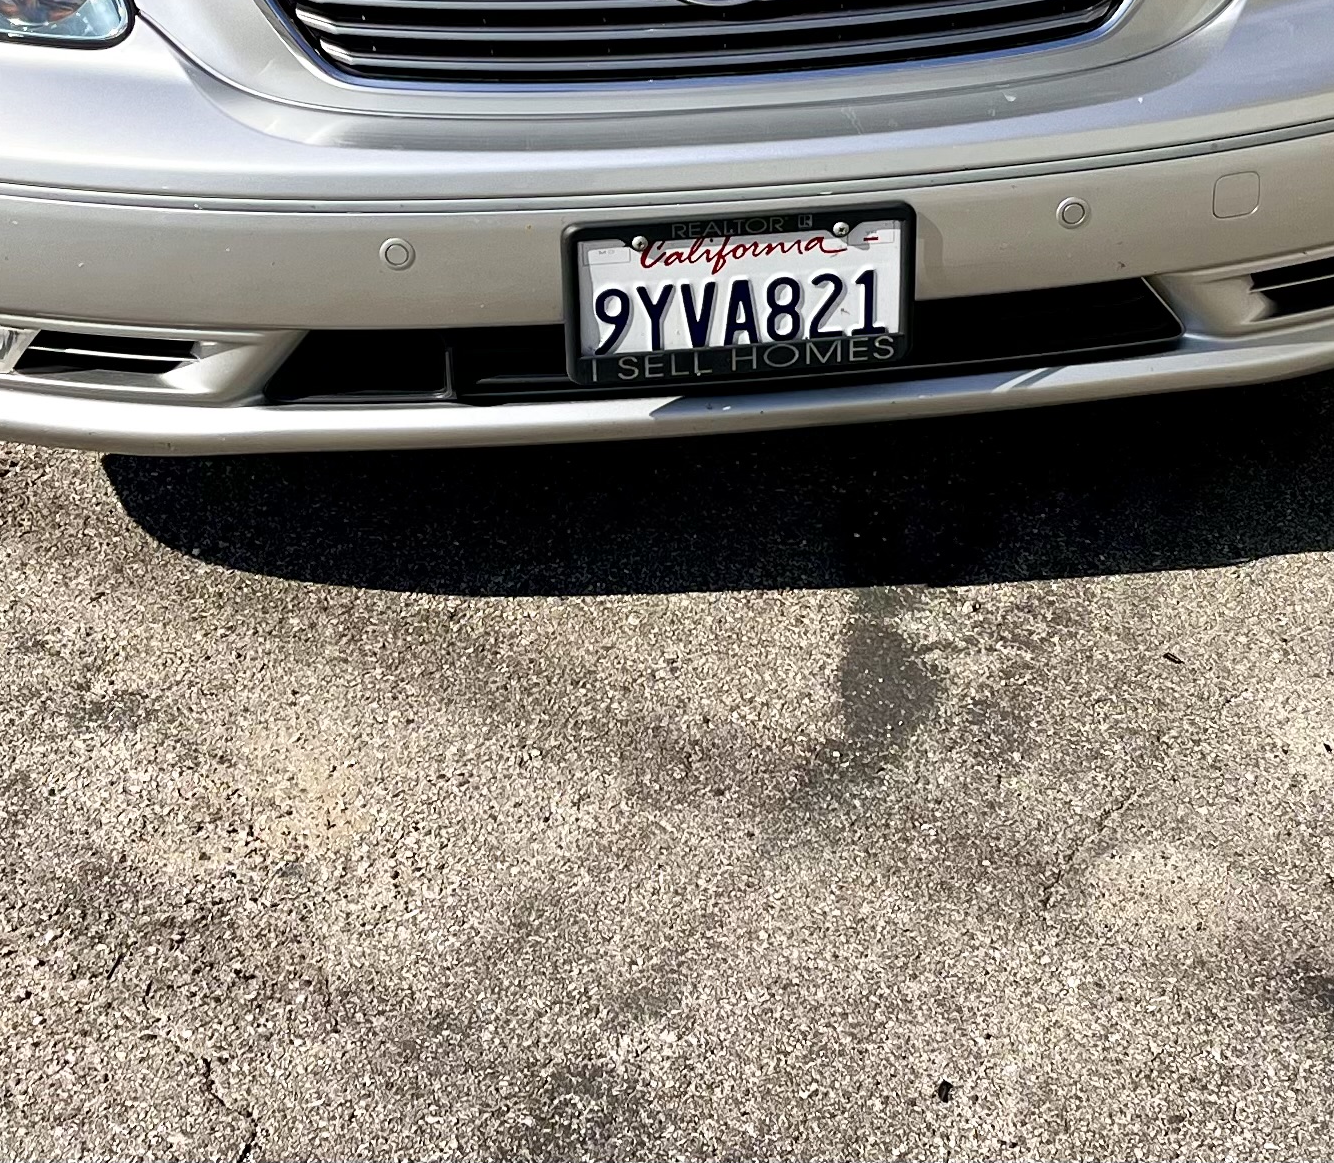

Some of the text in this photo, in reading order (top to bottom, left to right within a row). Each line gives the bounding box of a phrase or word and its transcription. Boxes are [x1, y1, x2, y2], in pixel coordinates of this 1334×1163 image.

[640, 236, 848, 276] California
[594, 268, 886, 356] 9YVA821
[591, 335, 895, 382] I SELL HOMES
